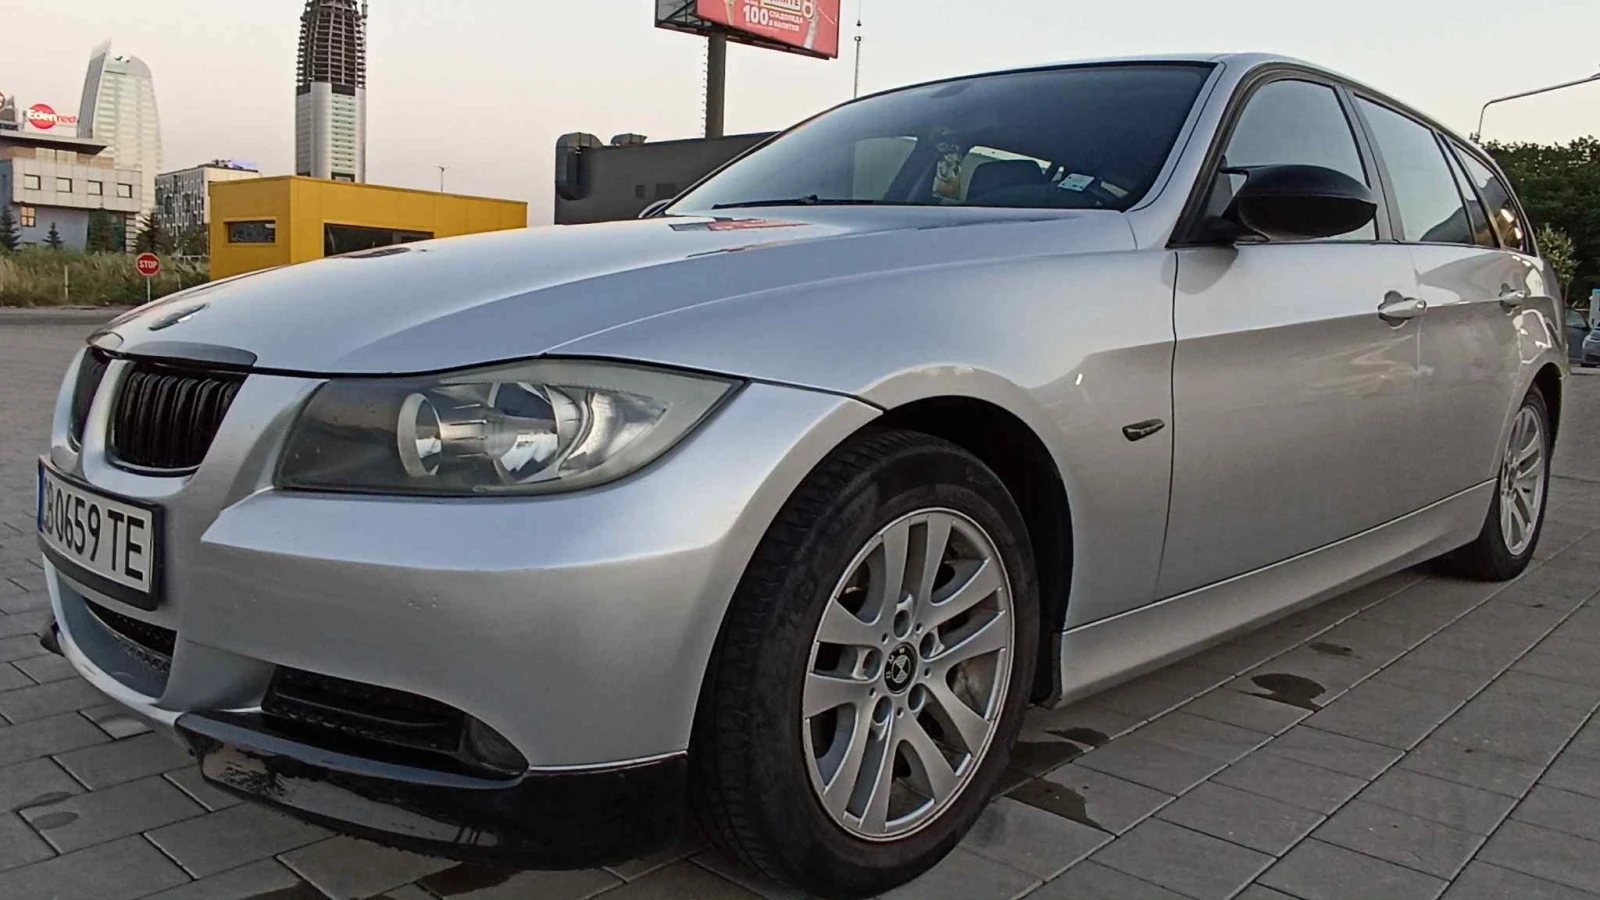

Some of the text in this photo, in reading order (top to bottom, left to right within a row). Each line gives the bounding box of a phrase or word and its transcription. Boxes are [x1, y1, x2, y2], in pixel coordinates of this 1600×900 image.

[743, 5, 769, 25] 100
[27, 108, 77, 124] Edenred
[139, 260, 158, 269] STOP
[107, 509, 145, 581] TE
